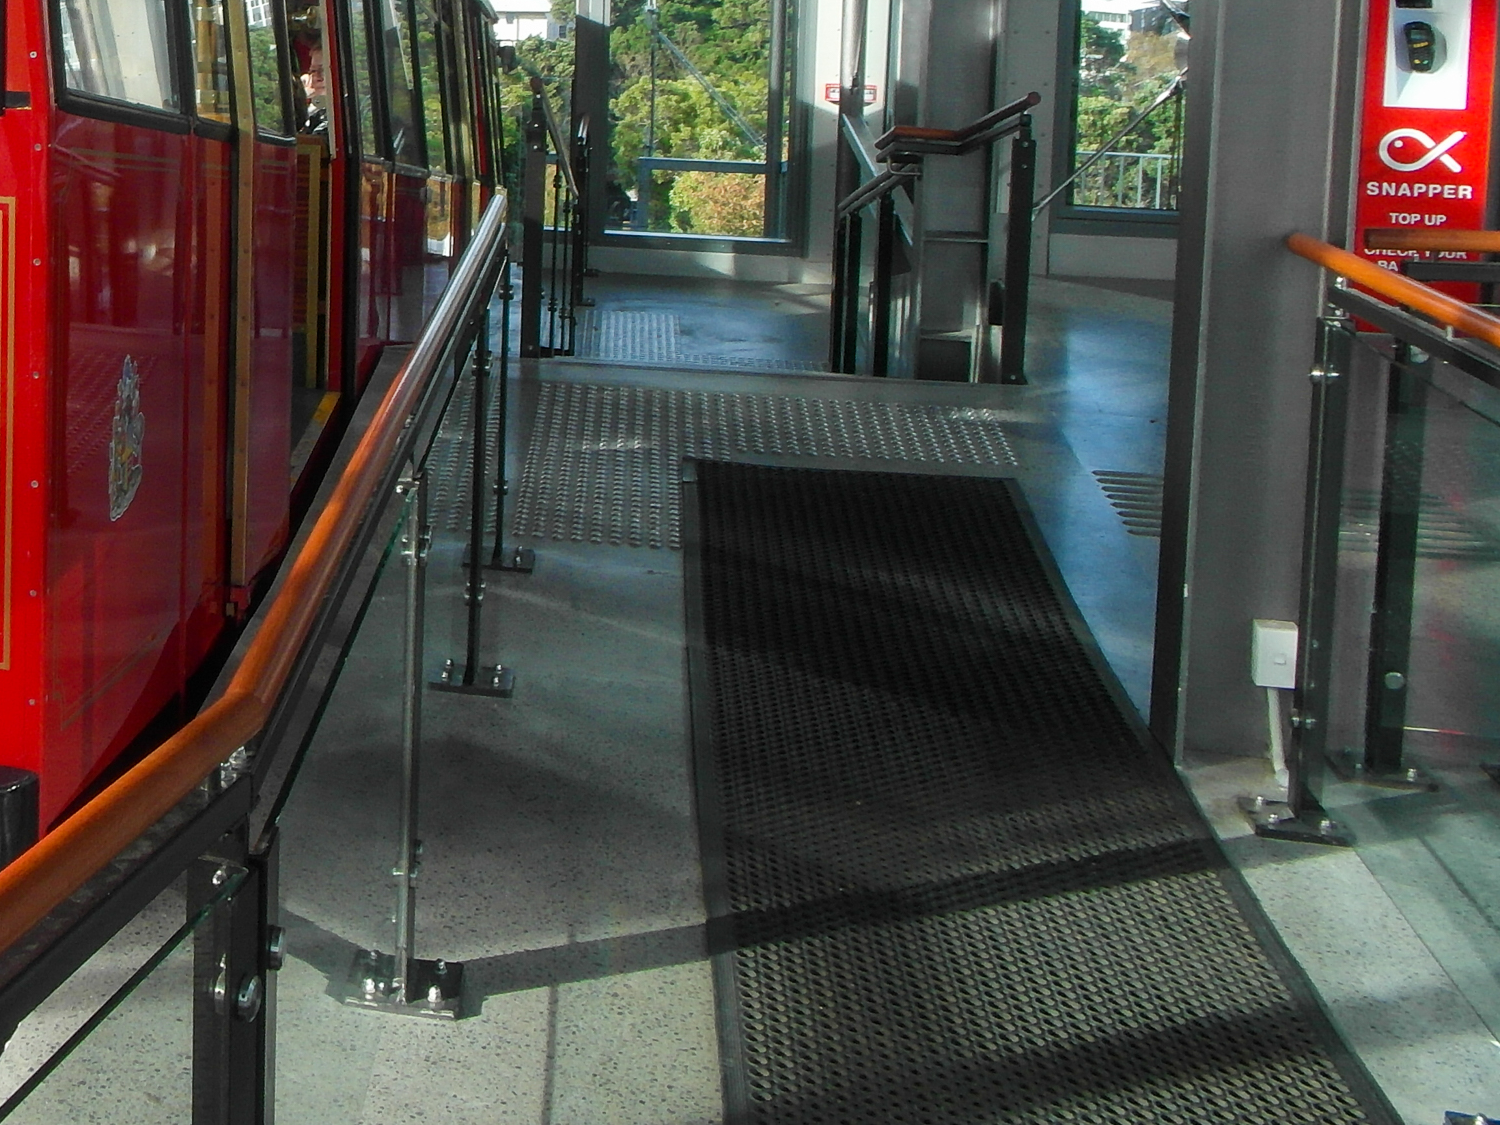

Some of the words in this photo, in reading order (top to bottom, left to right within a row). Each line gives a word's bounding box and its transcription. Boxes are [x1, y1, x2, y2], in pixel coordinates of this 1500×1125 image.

[1366, 181, 1473, 200] SNAPPER
[1389, 212, 1421, 225] TOP
[1424, 214, 1447, 226] UP
